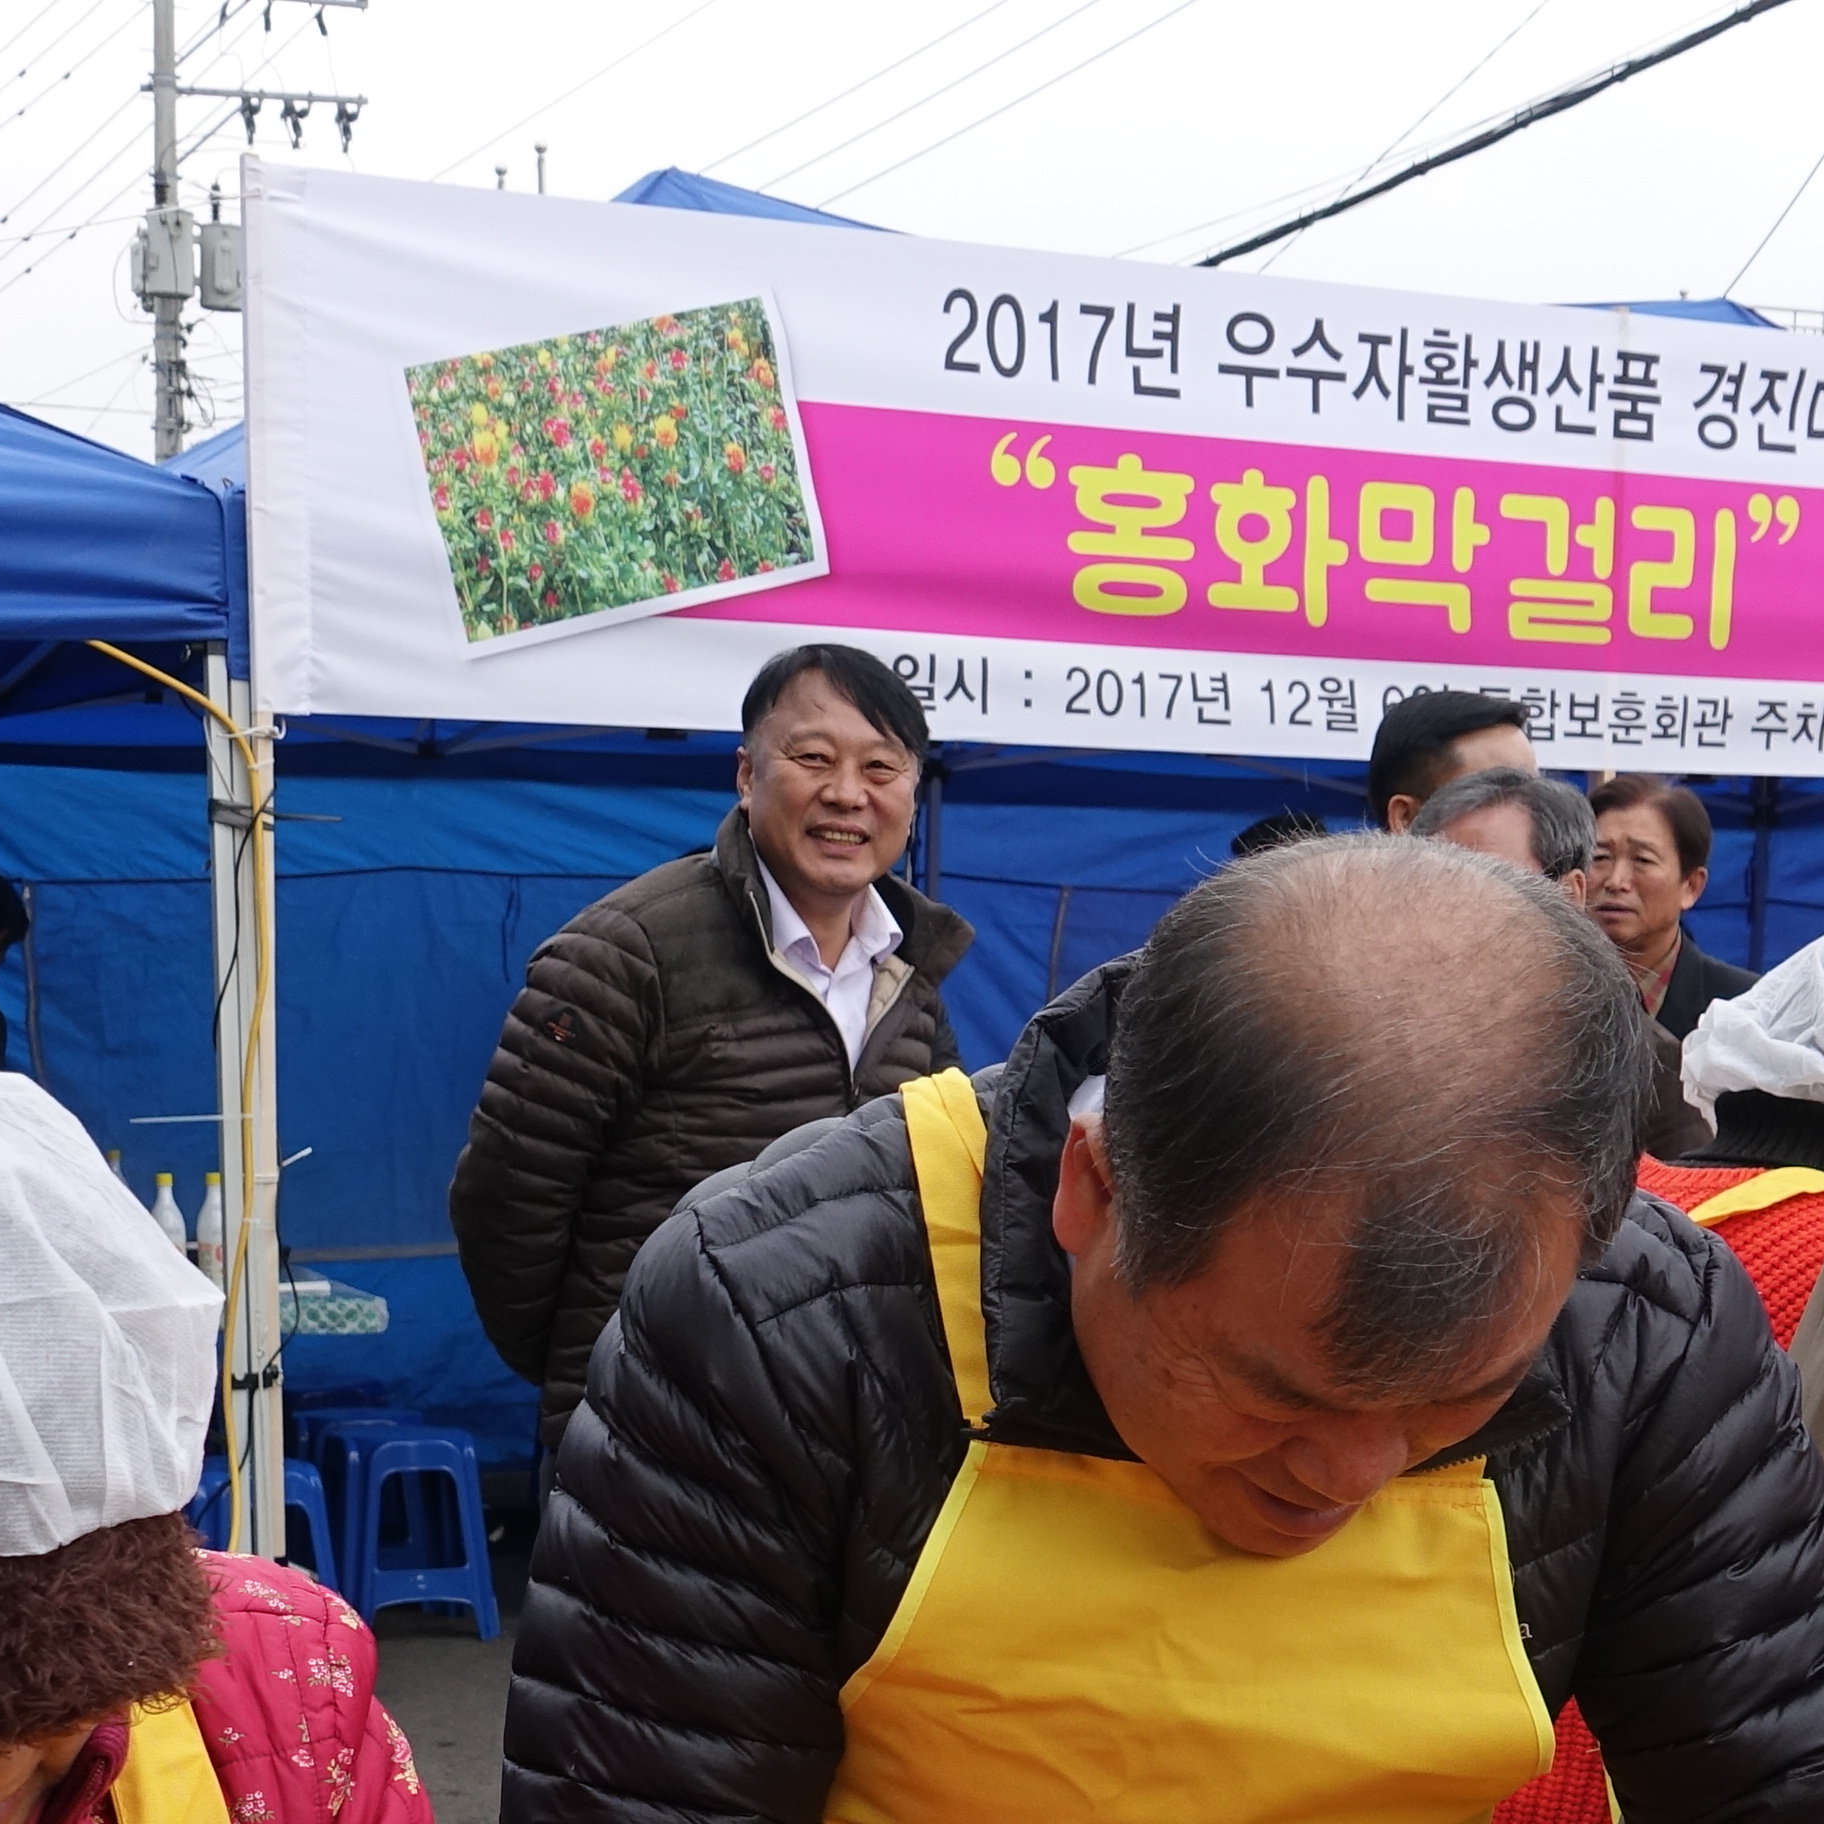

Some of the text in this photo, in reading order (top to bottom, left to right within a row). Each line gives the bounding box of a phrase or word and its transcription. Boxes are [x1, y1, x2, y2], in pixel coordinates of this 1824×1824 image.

[942, 287, 1182, 399] 2017년
[1218, 309, 1661, 442] 우수자활생산품
[990, 432, 1799, 650] “홍화막걸리”
[1064, 665, 1233, 726] 2017년
[1261, 674, 1360, 734] 12월
